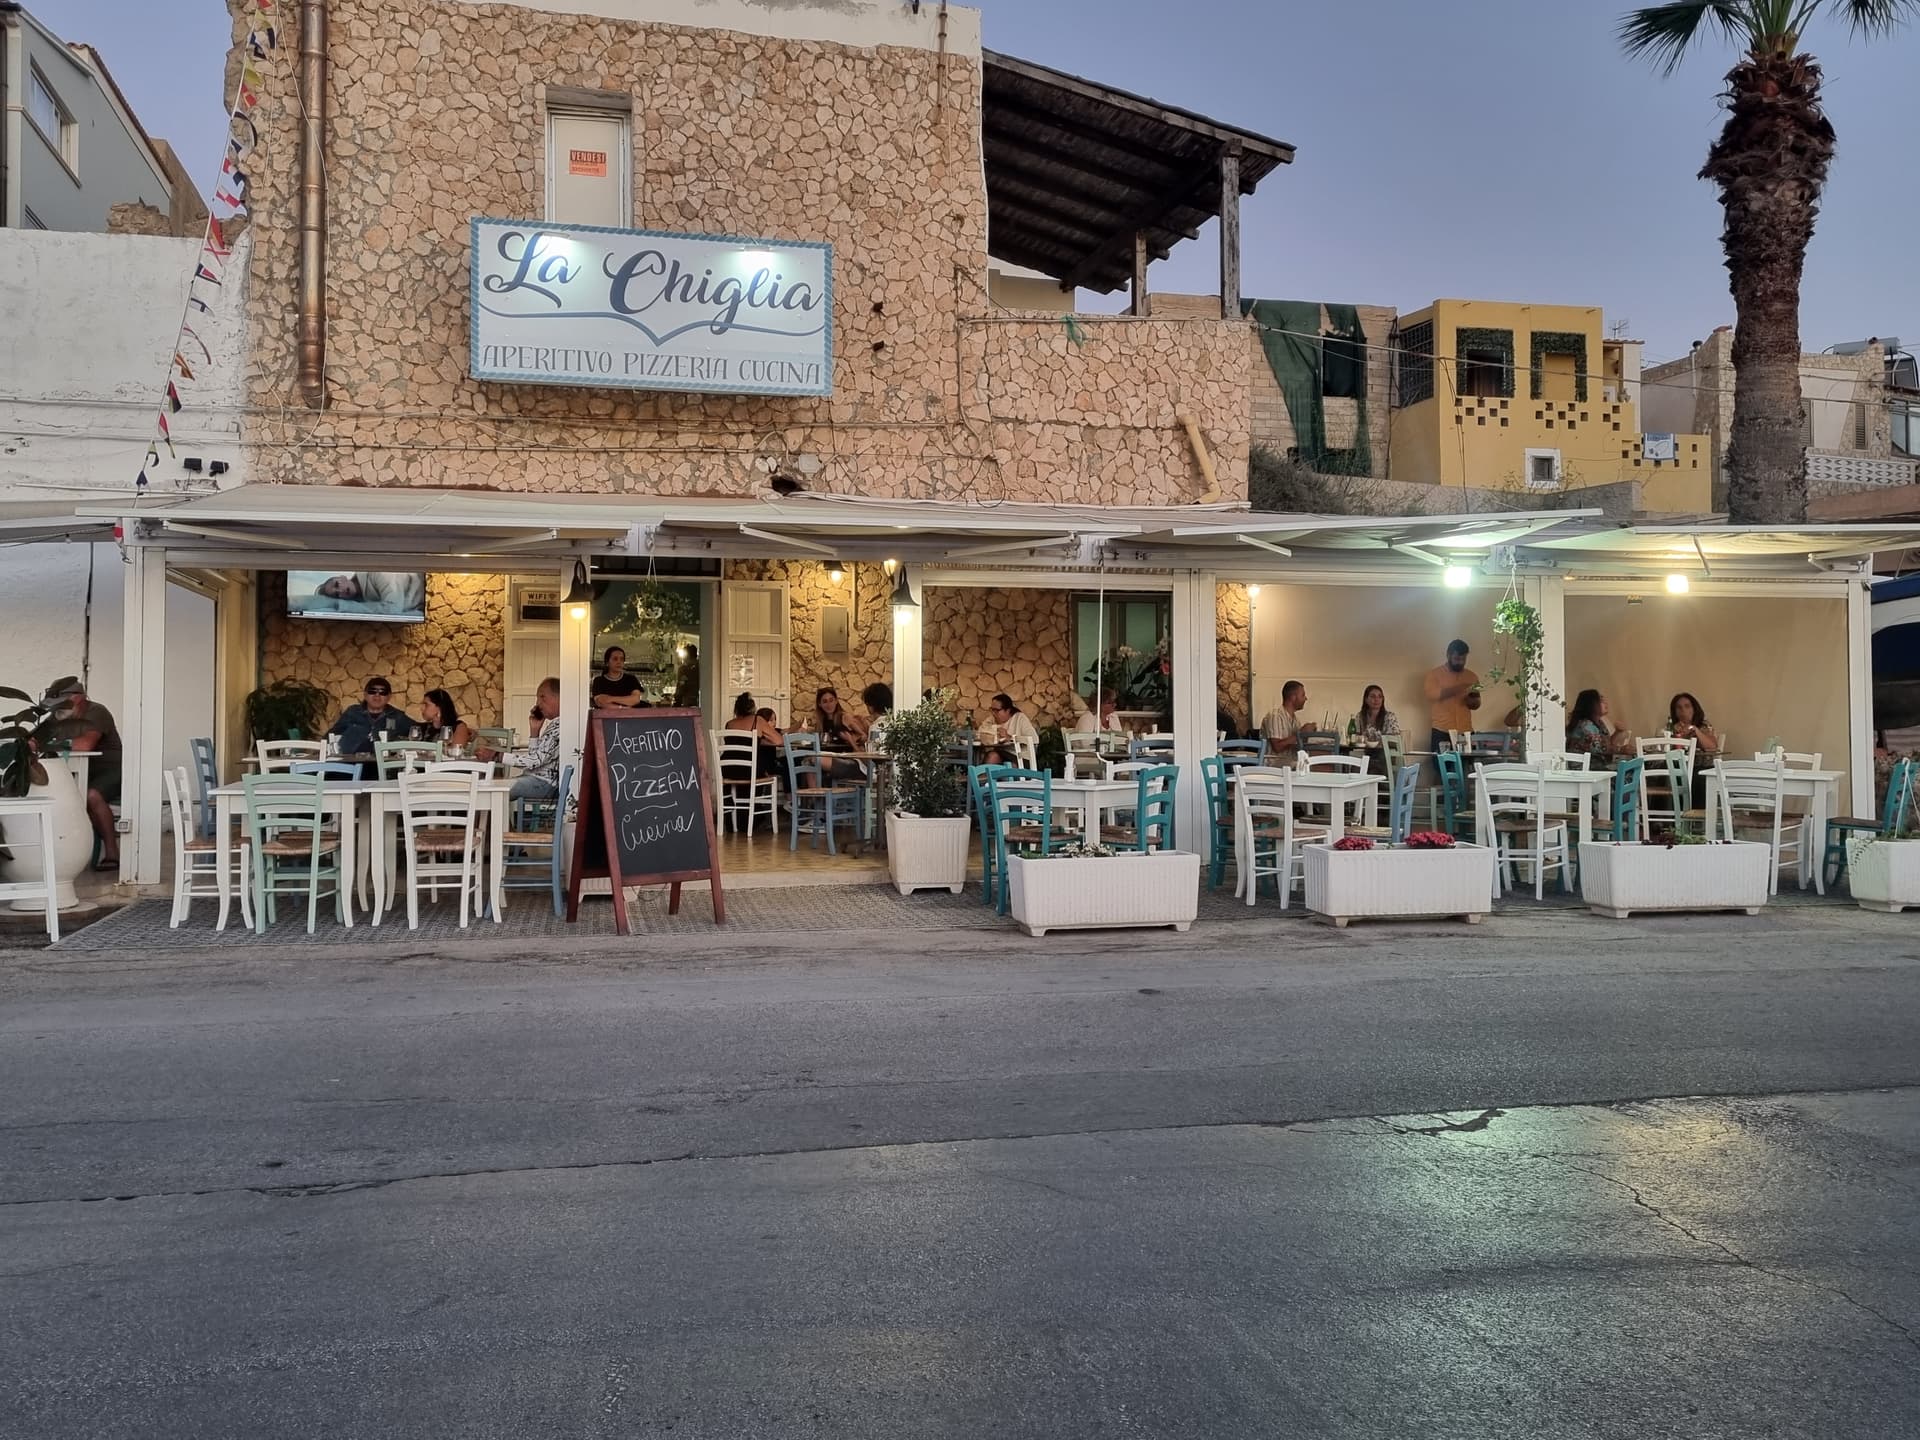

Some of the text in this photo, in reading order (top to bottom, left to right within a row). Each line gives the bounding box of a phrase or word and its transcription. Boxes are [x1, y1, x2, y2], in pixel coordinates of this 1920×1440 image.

[571, 151, 605, 163] VENDESI
[483, 231, 823, 335] La Chiglia
[483, 344, 820, 385] APERITIVO PIZZERIA CUCINA
[621, 811, 696, 851] Cucina
